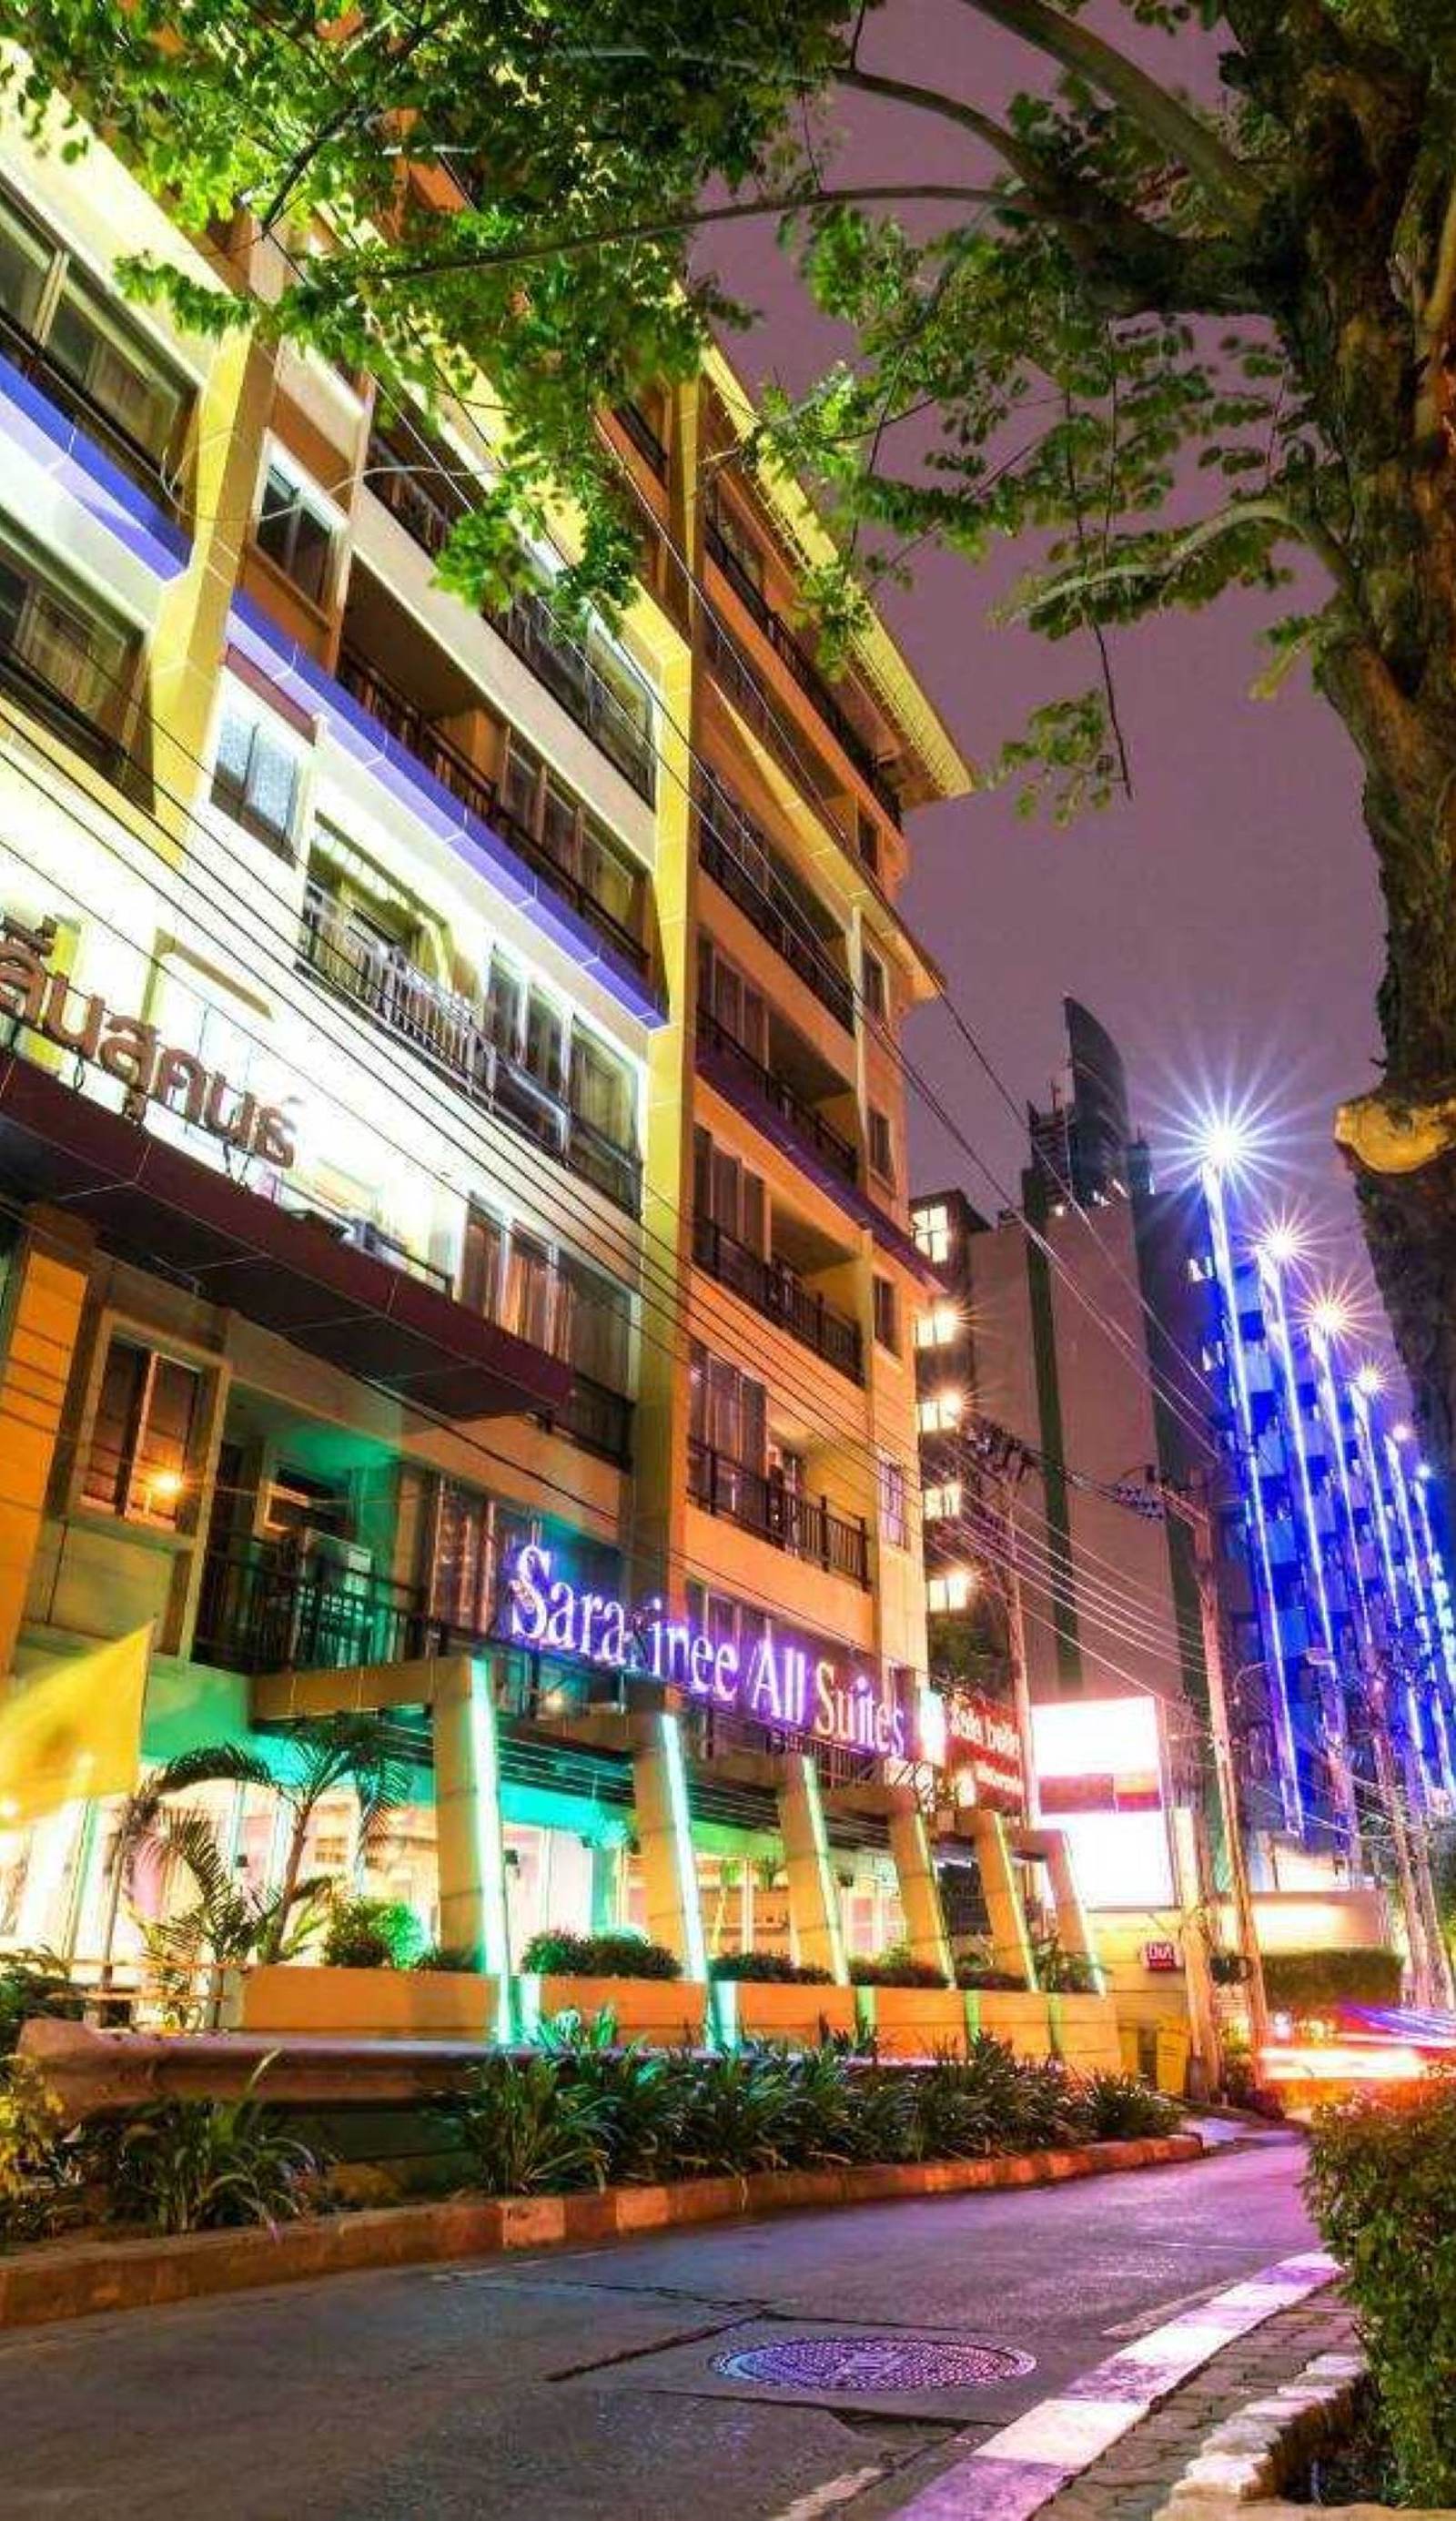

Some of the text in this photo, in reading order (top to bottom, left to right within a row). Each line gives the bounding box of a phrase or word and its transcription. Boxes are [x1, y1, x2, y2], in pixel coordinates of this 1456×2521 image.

[509, 1545, 738, 1702] Sarainee
[751, 1637, 805, 1725] All
[814, 1662, 904, 1758] Suites
